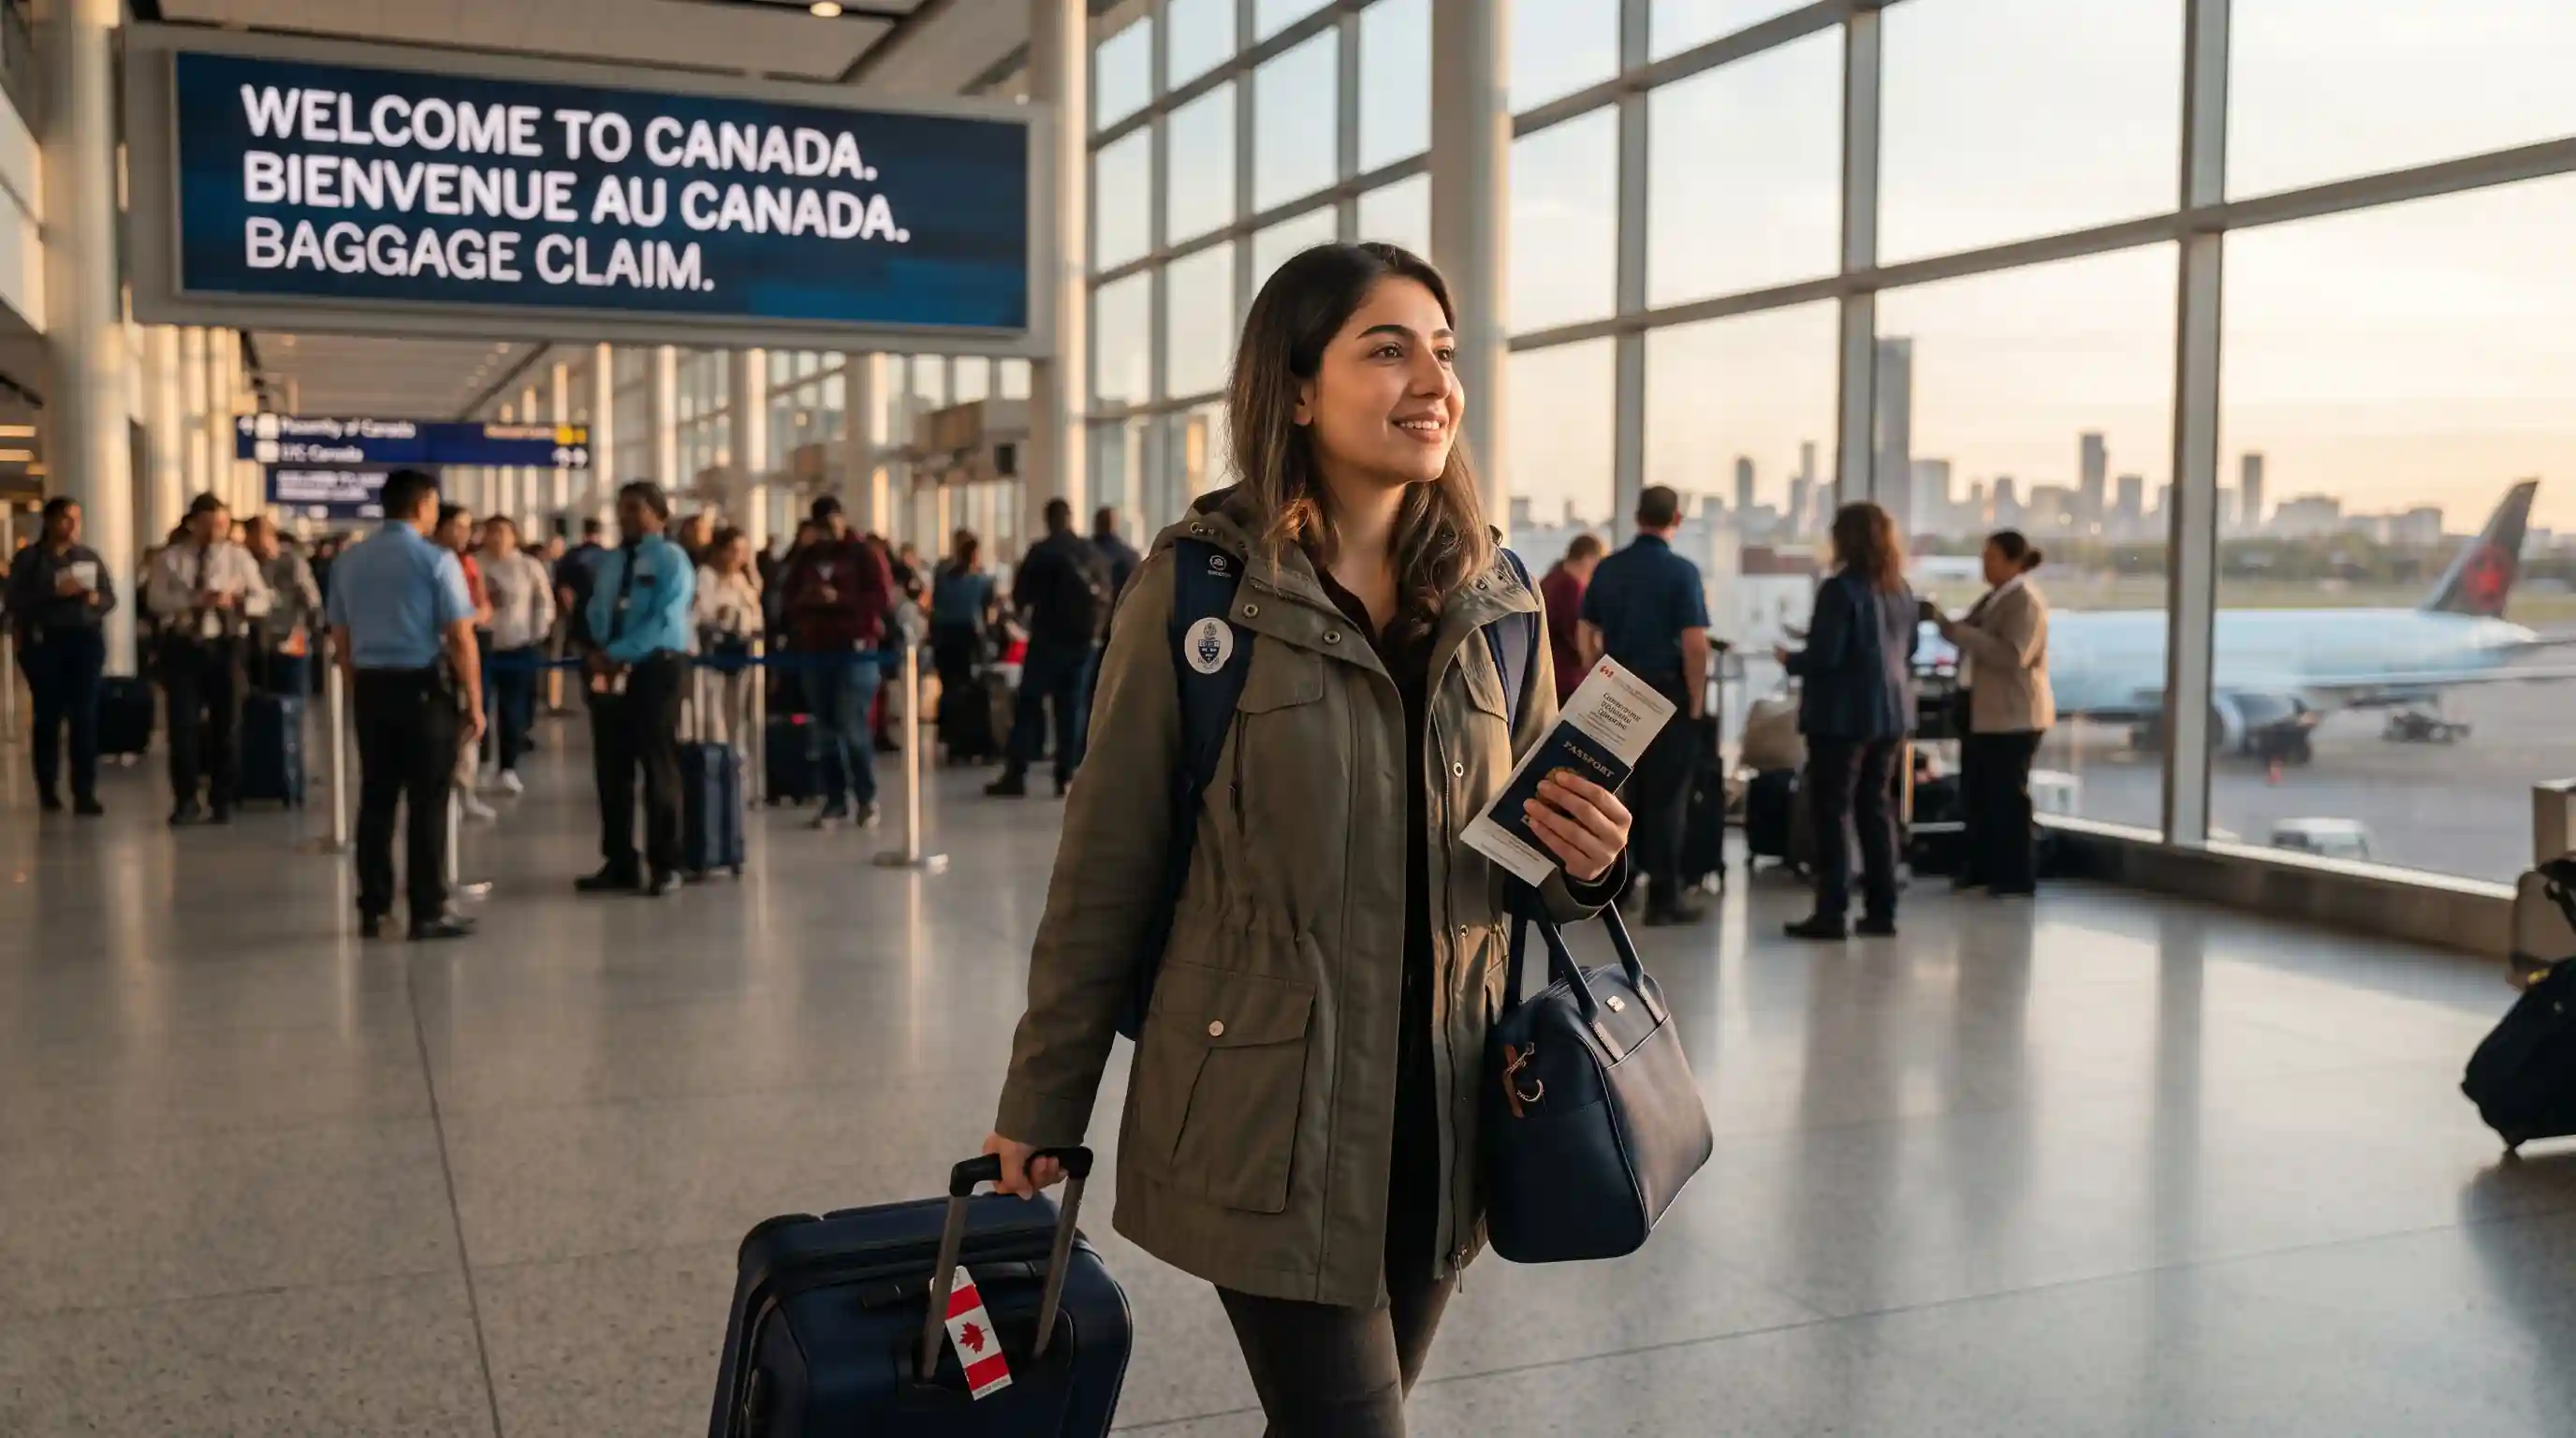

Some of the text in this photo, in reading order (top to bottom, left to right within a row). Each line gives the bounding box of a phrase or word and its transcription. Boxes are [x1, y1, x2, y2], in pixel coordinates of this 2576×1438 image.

[241, 84, 878, 182] WELCOME TO CANADA.
[244, 150, 911, 243] BIENVENUE AU CANADA.
[245, 216, 715, 292] BAGGAGE CLAIM.
